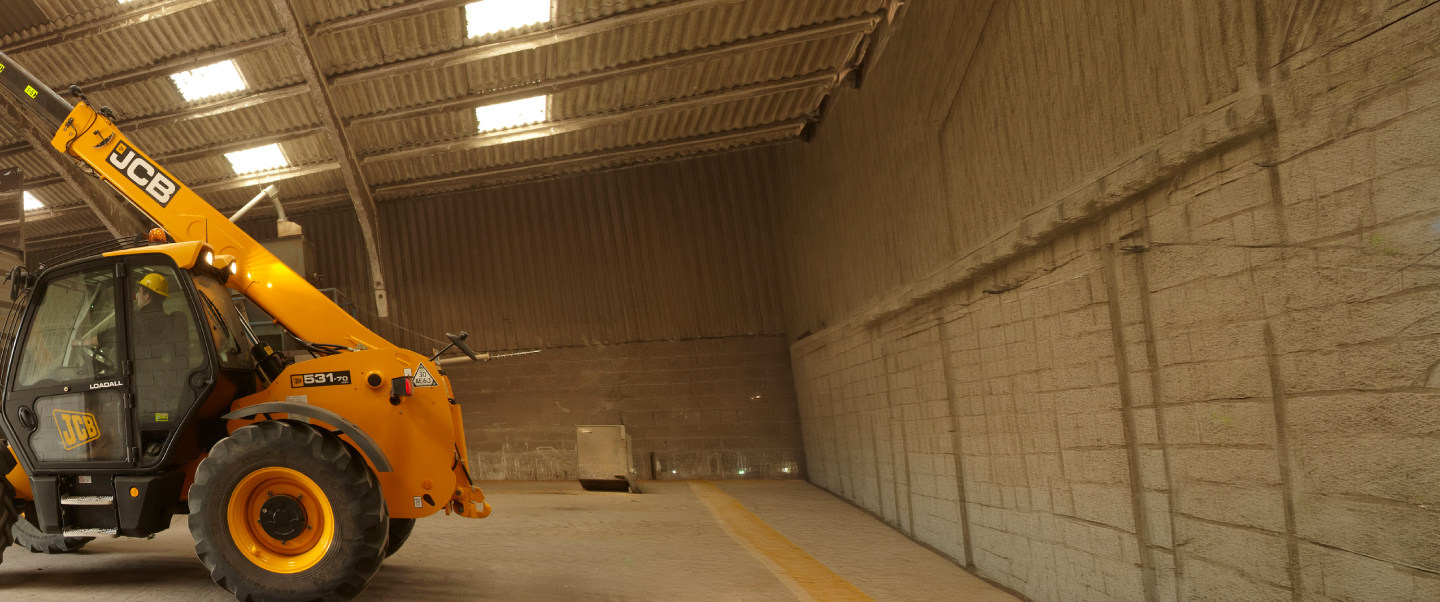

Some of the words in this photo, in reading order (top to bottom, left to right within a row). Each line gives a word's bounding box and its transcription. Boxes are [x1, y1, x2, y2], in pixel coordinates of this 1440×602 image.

[109, 150, 176, 204] JCB
[89, 380, 123, 390] LOADALL
[61, 413, 98, 446] JCB
